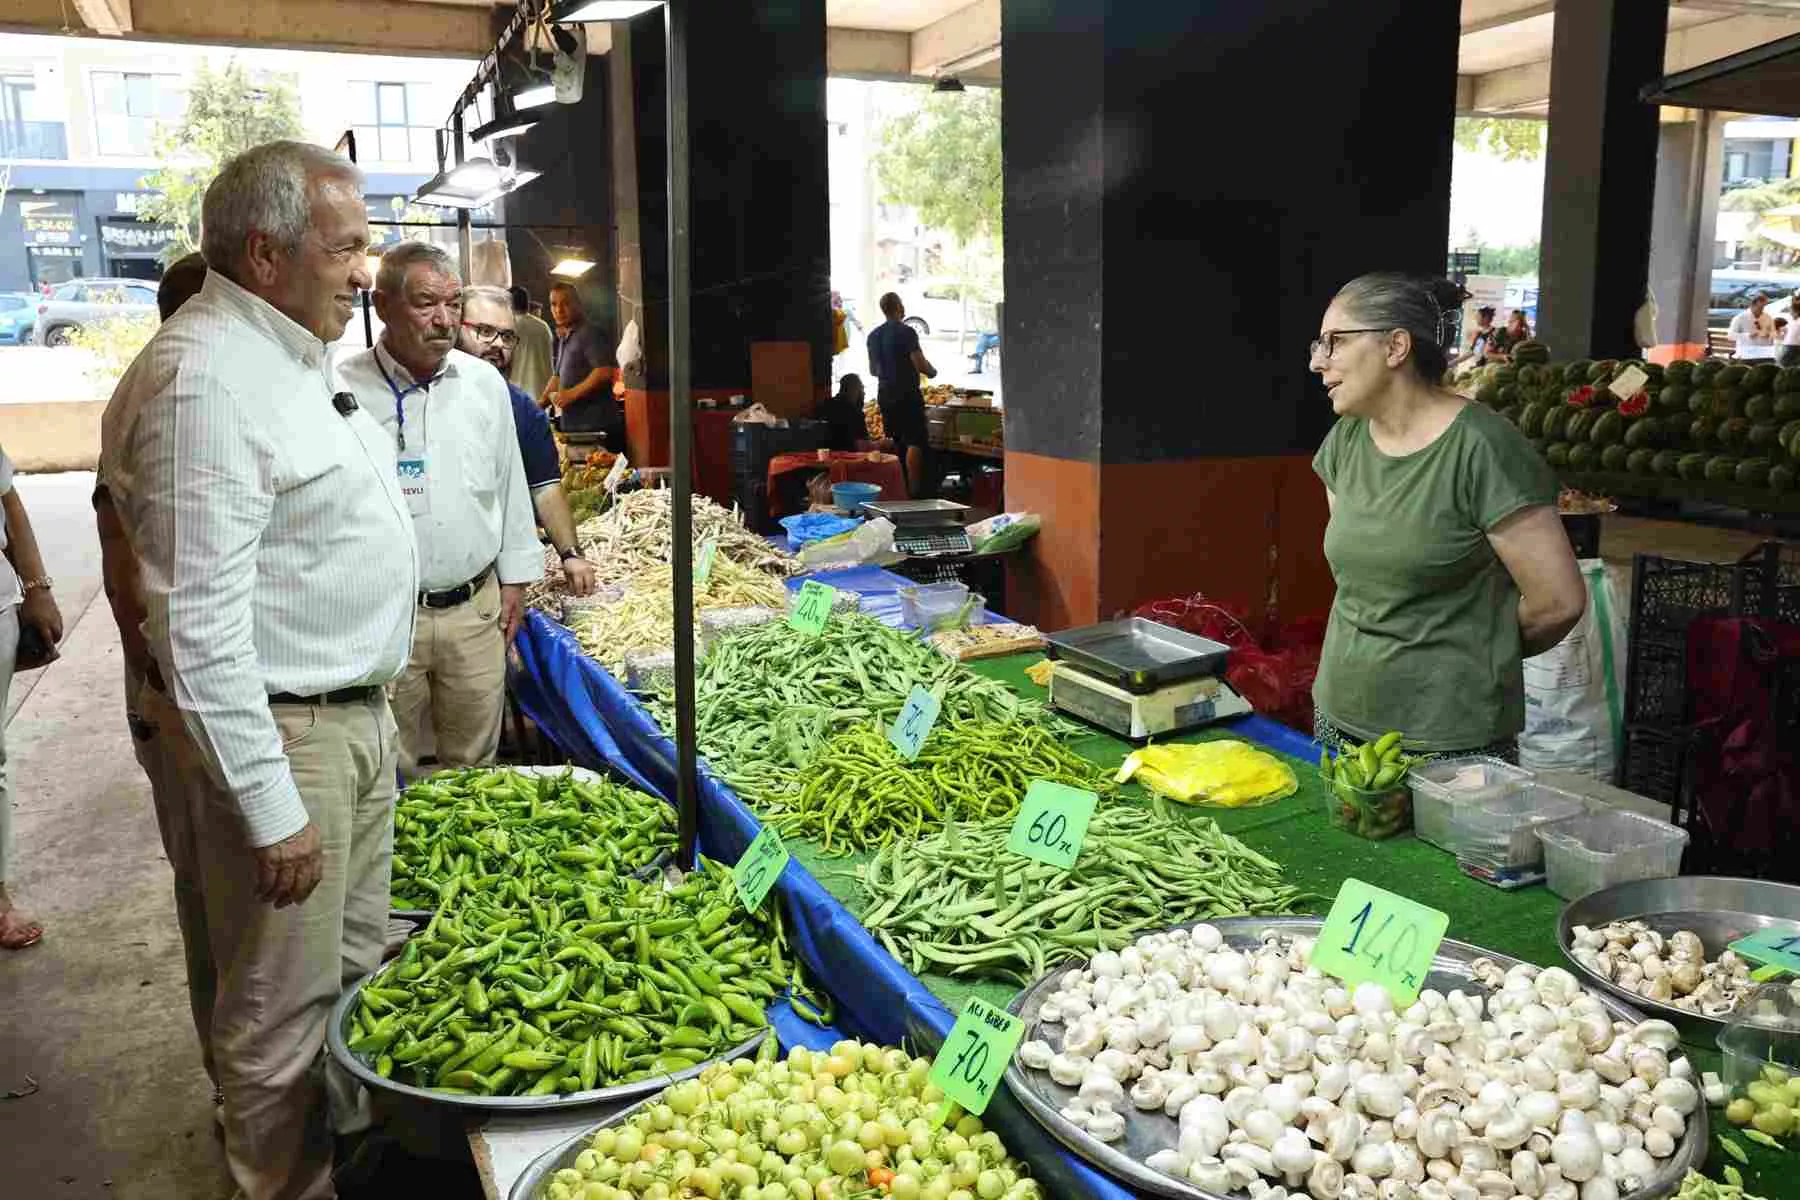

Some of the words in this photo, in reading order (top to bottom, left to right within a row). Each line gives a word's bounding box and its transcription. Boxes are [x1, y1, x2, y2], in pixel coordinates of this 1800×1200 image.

[1028, 809, 1066, 848] 60
[1341, 900, 1419, 974] 140
[948, 1030, 990, 1084] 70
